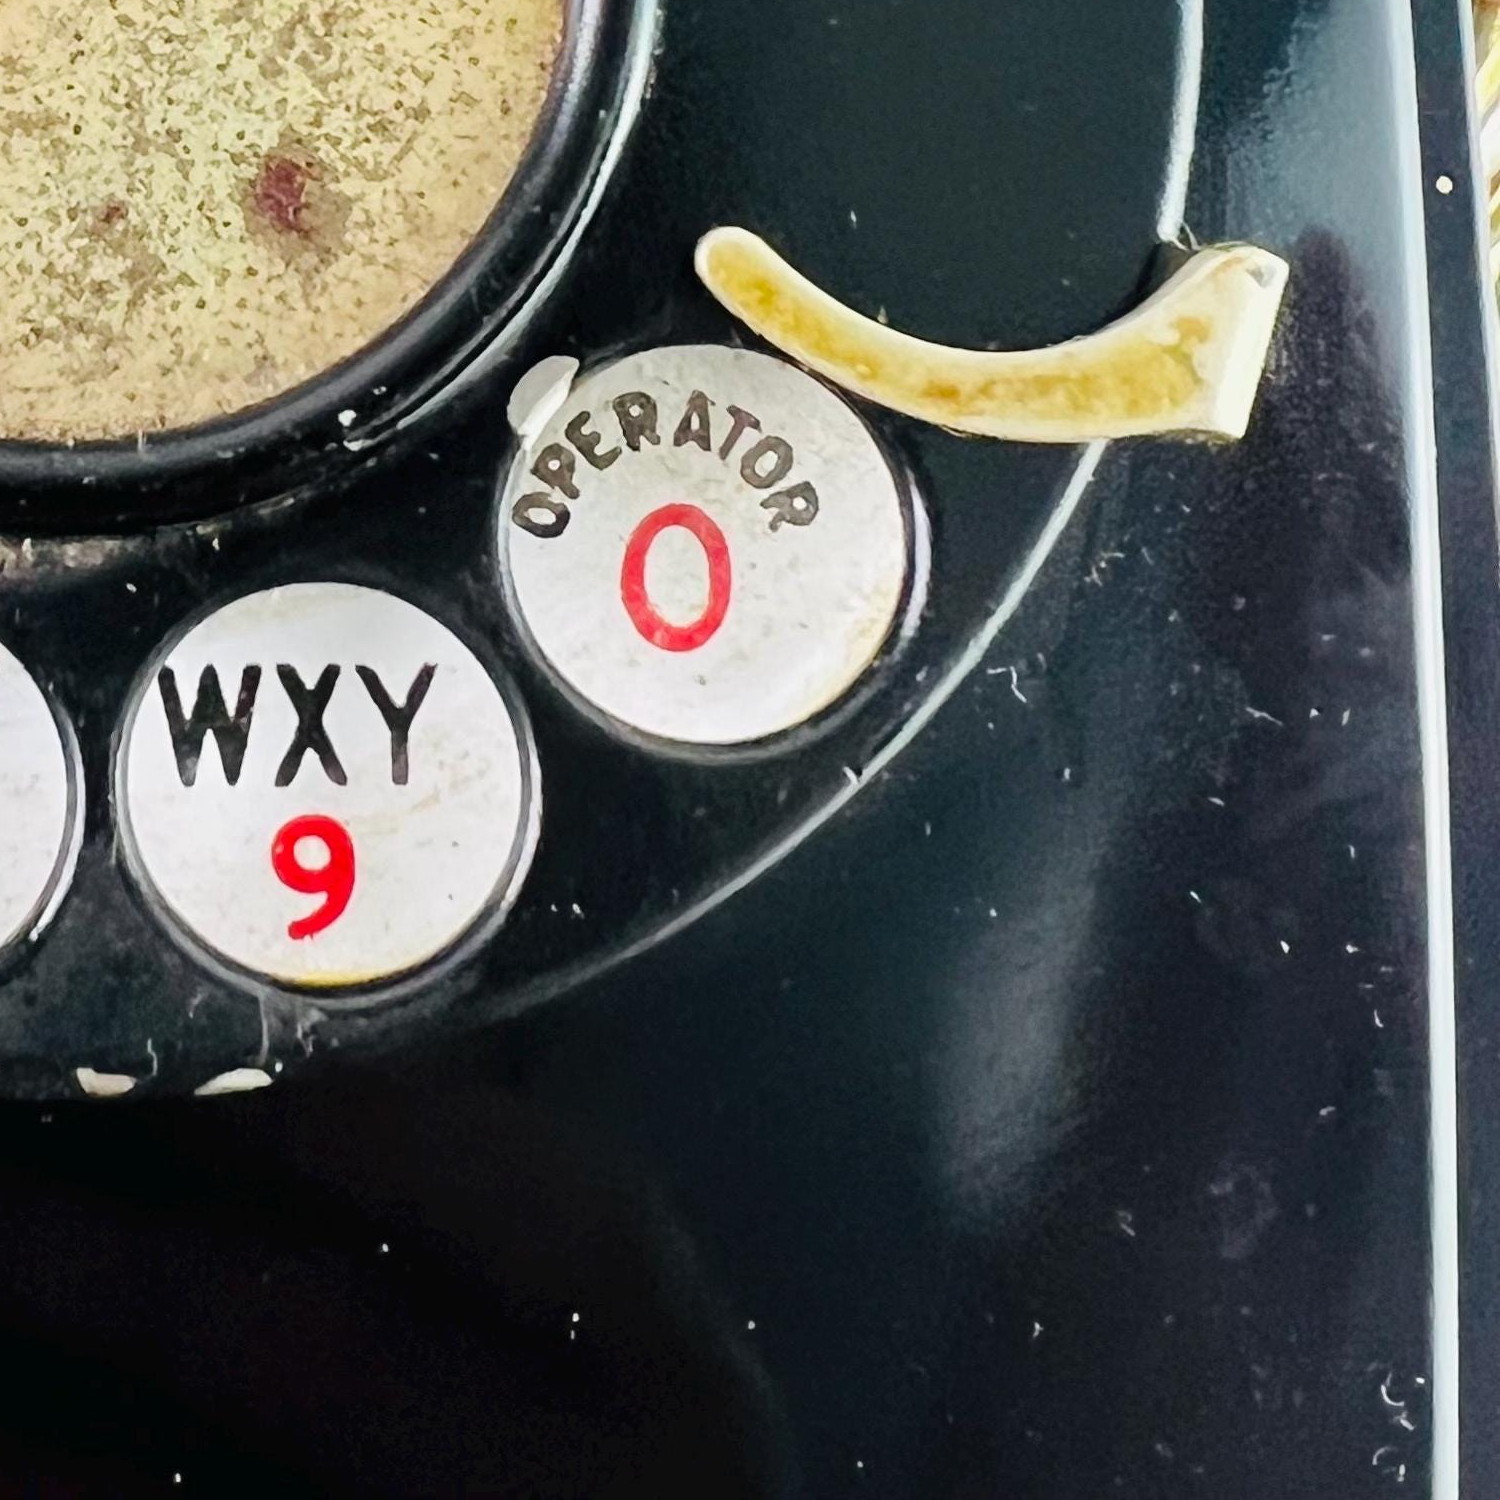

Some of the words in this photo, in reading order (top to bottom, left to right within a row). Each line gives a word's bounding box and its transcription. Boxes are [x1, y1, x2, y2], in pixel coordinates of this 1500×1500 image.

[511, 390, 819, 539] OPERATOR
[620, 503, 732, 653] 0
[157, 663, 438, 788] WXY
[270, 814, 356, 941] 9
